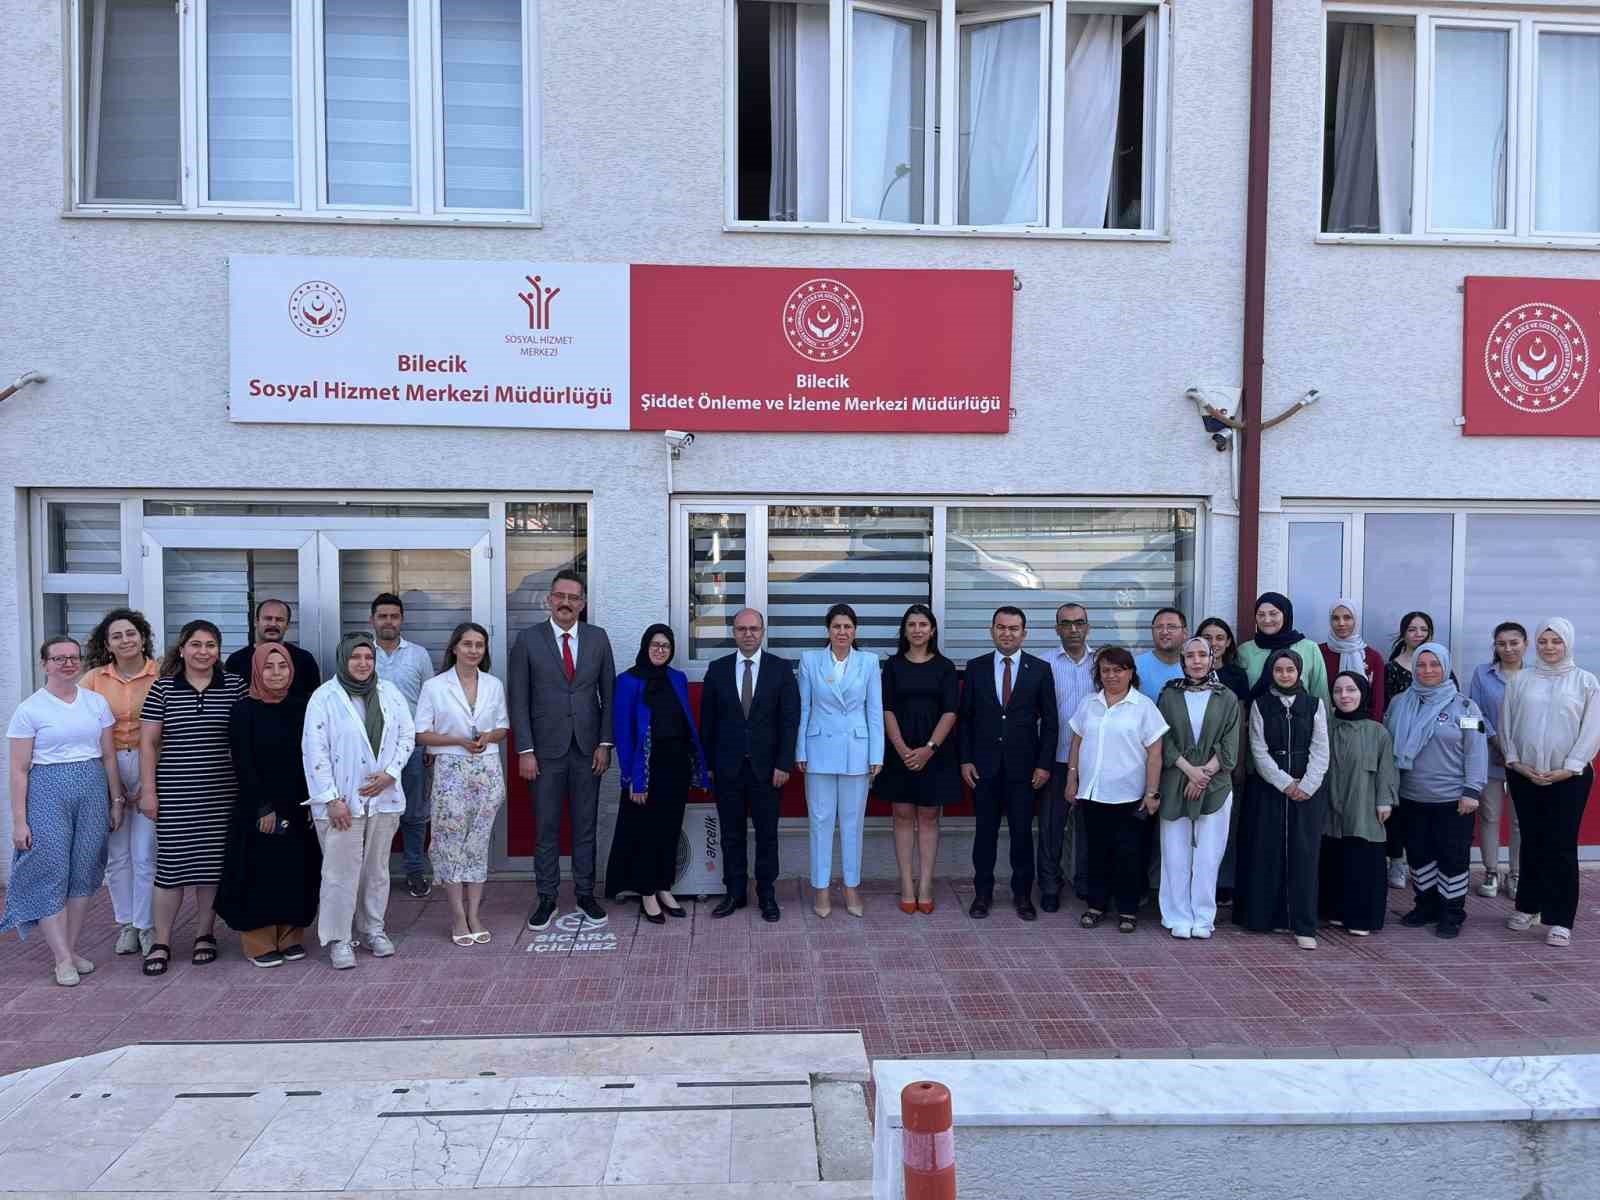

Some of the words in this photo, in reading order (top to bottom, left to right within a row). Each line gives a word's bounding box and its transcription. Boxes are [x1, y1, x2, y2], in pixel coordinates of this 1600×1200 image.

[504, 335, 539, 345] SOSYAL
[398, 354, 468, 373] Bilecik
[796, 373, 850, 389] Bilecik
[250, 379, 318, 402] Sosyal
[324, 381, 399, 401] Hizmet
[406, 383, 489, 402] Merkezi
[495, 385, 612, 409] Müdürlüğü
[641, 393, 694, 413] Şiddet
[698, 392, 762, 411] Önleme
[765, 399, 785, 411] ve
[788, 393, 841, 412] İzleme
[844, 395, 908, 412] Merkezi
[911, 396, 1001, 415] Müdürlüğü
